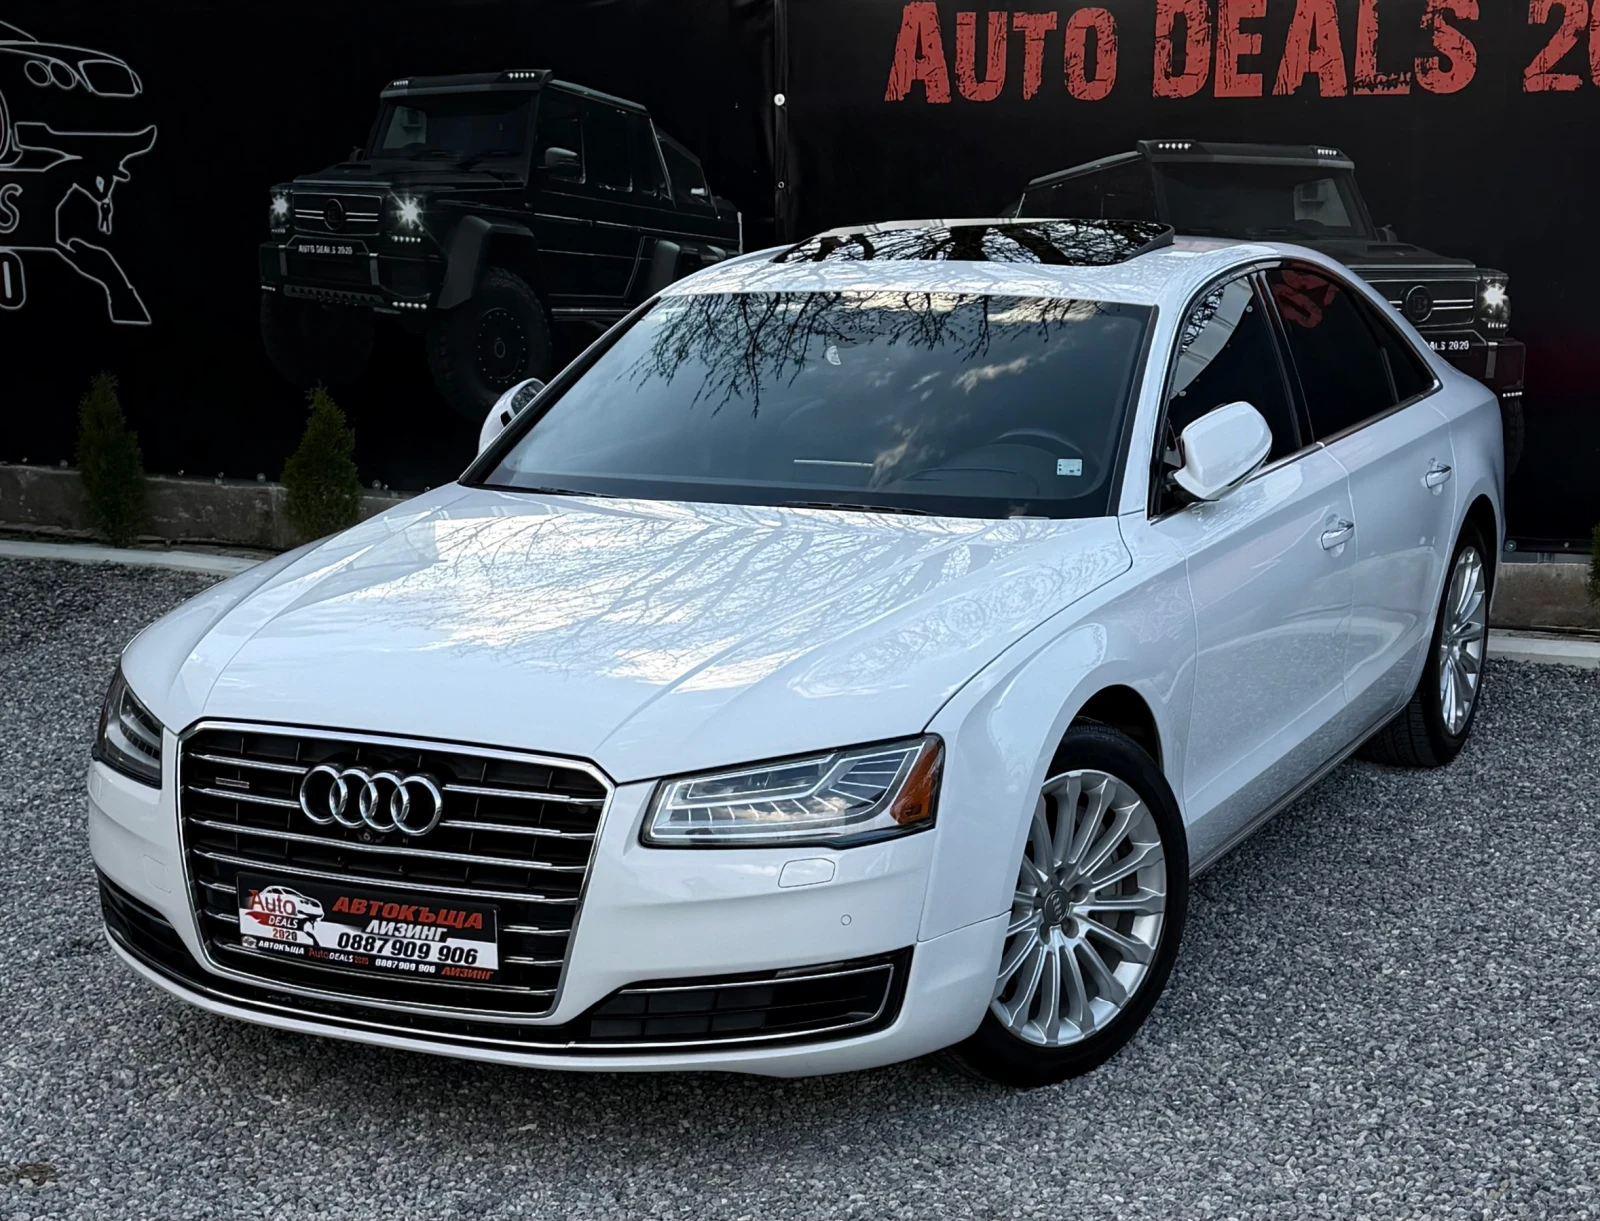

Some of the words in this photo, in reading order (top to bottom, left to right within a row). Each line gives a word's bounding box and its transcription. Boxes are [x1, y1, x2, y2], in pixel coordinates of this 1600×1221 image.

[884, 1, 1119, 104] AUTO
[1152, 0, 1480, 98] DEALS
[1523, 0, 1600, 93] 2
[1448, 340, 1470, 351] 2020
[248, 889, 298, 916] Auto
[332, 896, 483, 929] АВТОКЪЩА
[268, 915, 299, 928] DEALS
[272, 927, 298, 941] 2020
[365, 919, 448, 942] ЛИЗИНГ
[258, 940, 304, 955] АВТОКЪЩА
[437, 945, 479, 965] 906
[441, 966, 494, 980] ЛИЗИНГ
